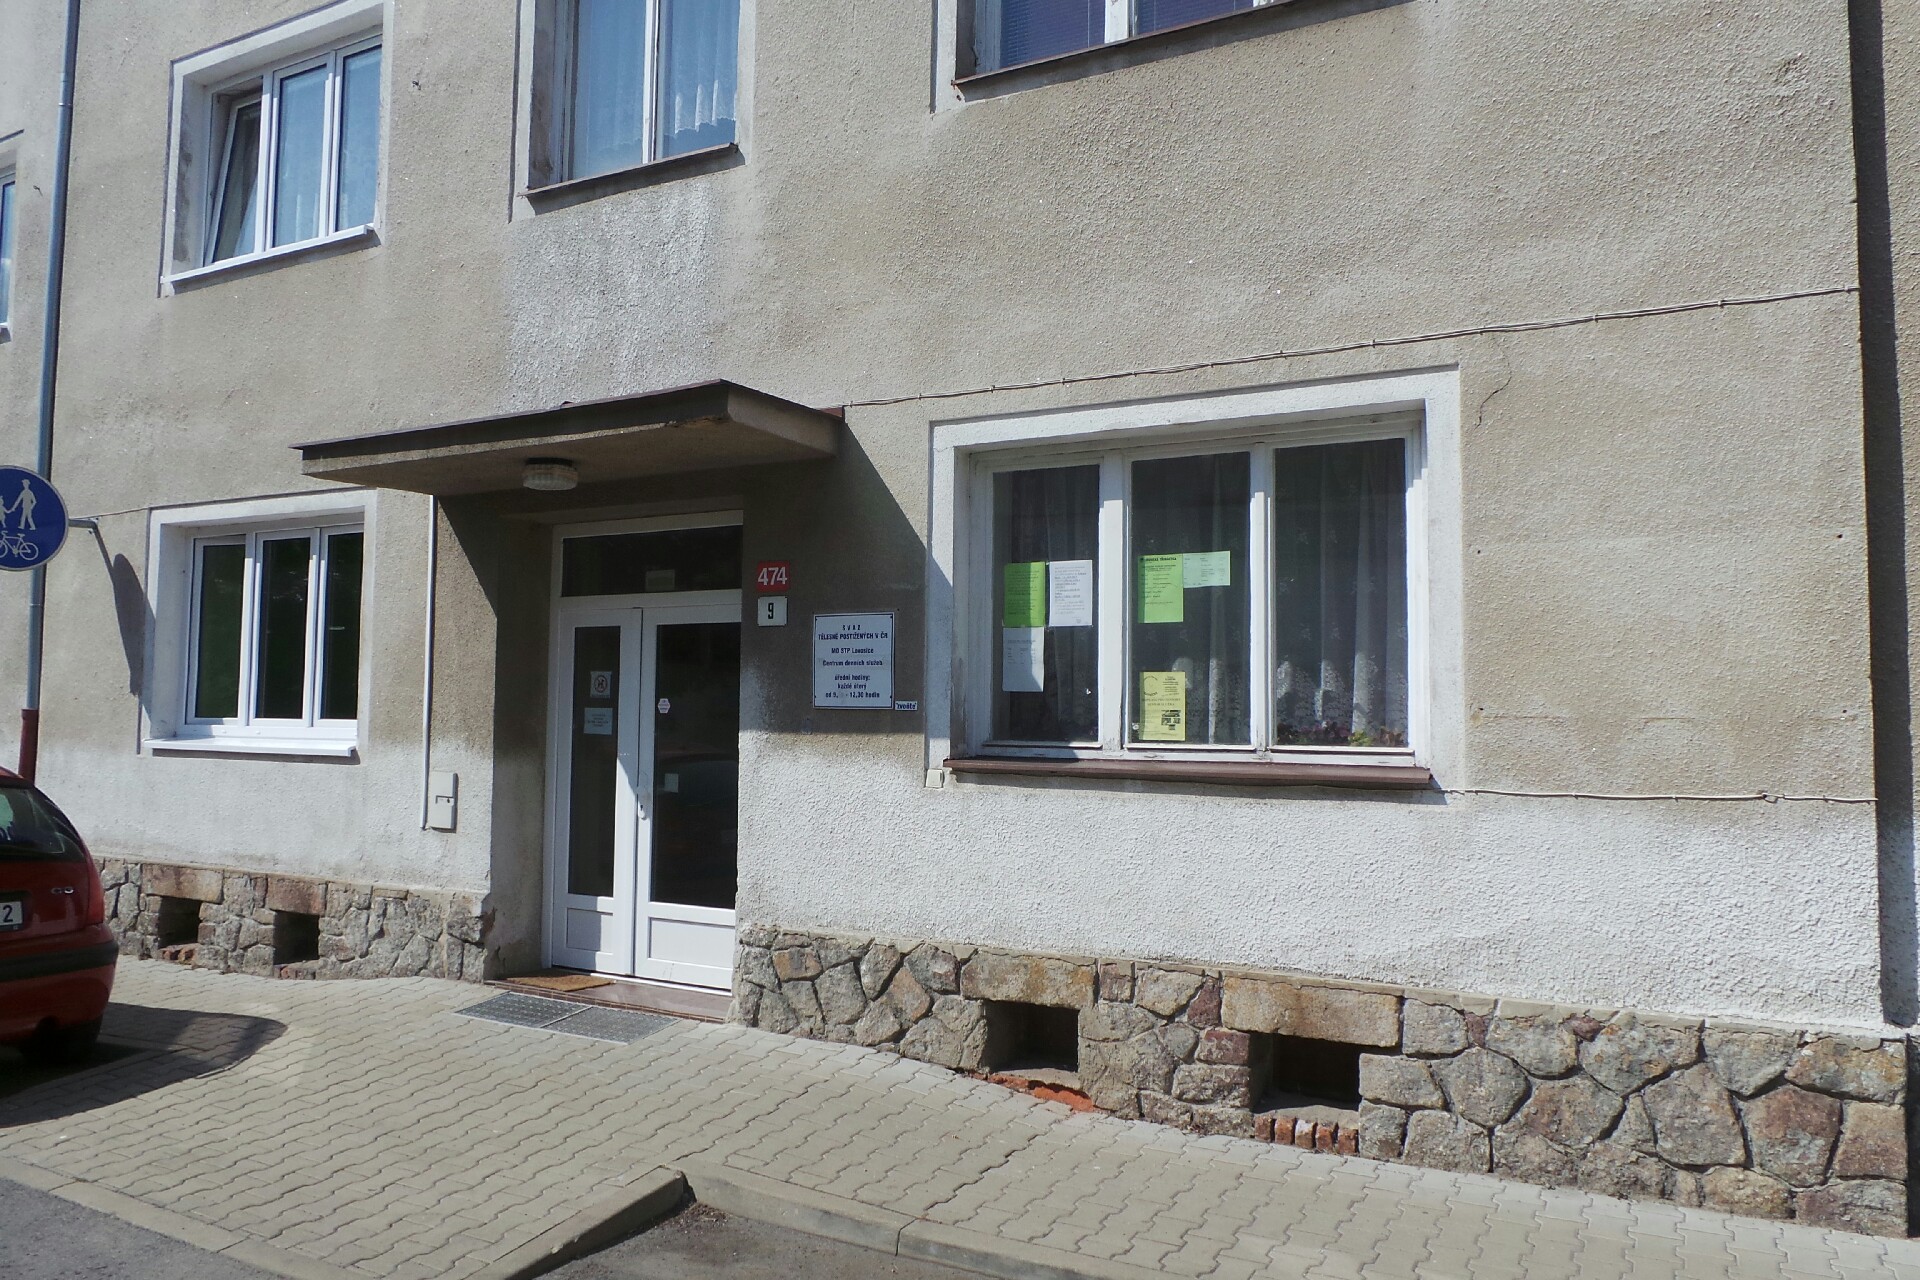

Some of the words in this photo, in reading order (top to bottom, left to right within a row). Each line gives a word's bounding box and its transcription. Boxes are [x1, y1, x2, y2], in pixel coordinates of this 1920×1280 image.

[757, 567, 787, 585] 474
[767, 602, 774, 619] 9
[880, 630, 888, 639] ČR
[851, 674, 871, 682] hodiny:
[3, 904, 13, 923] 2
